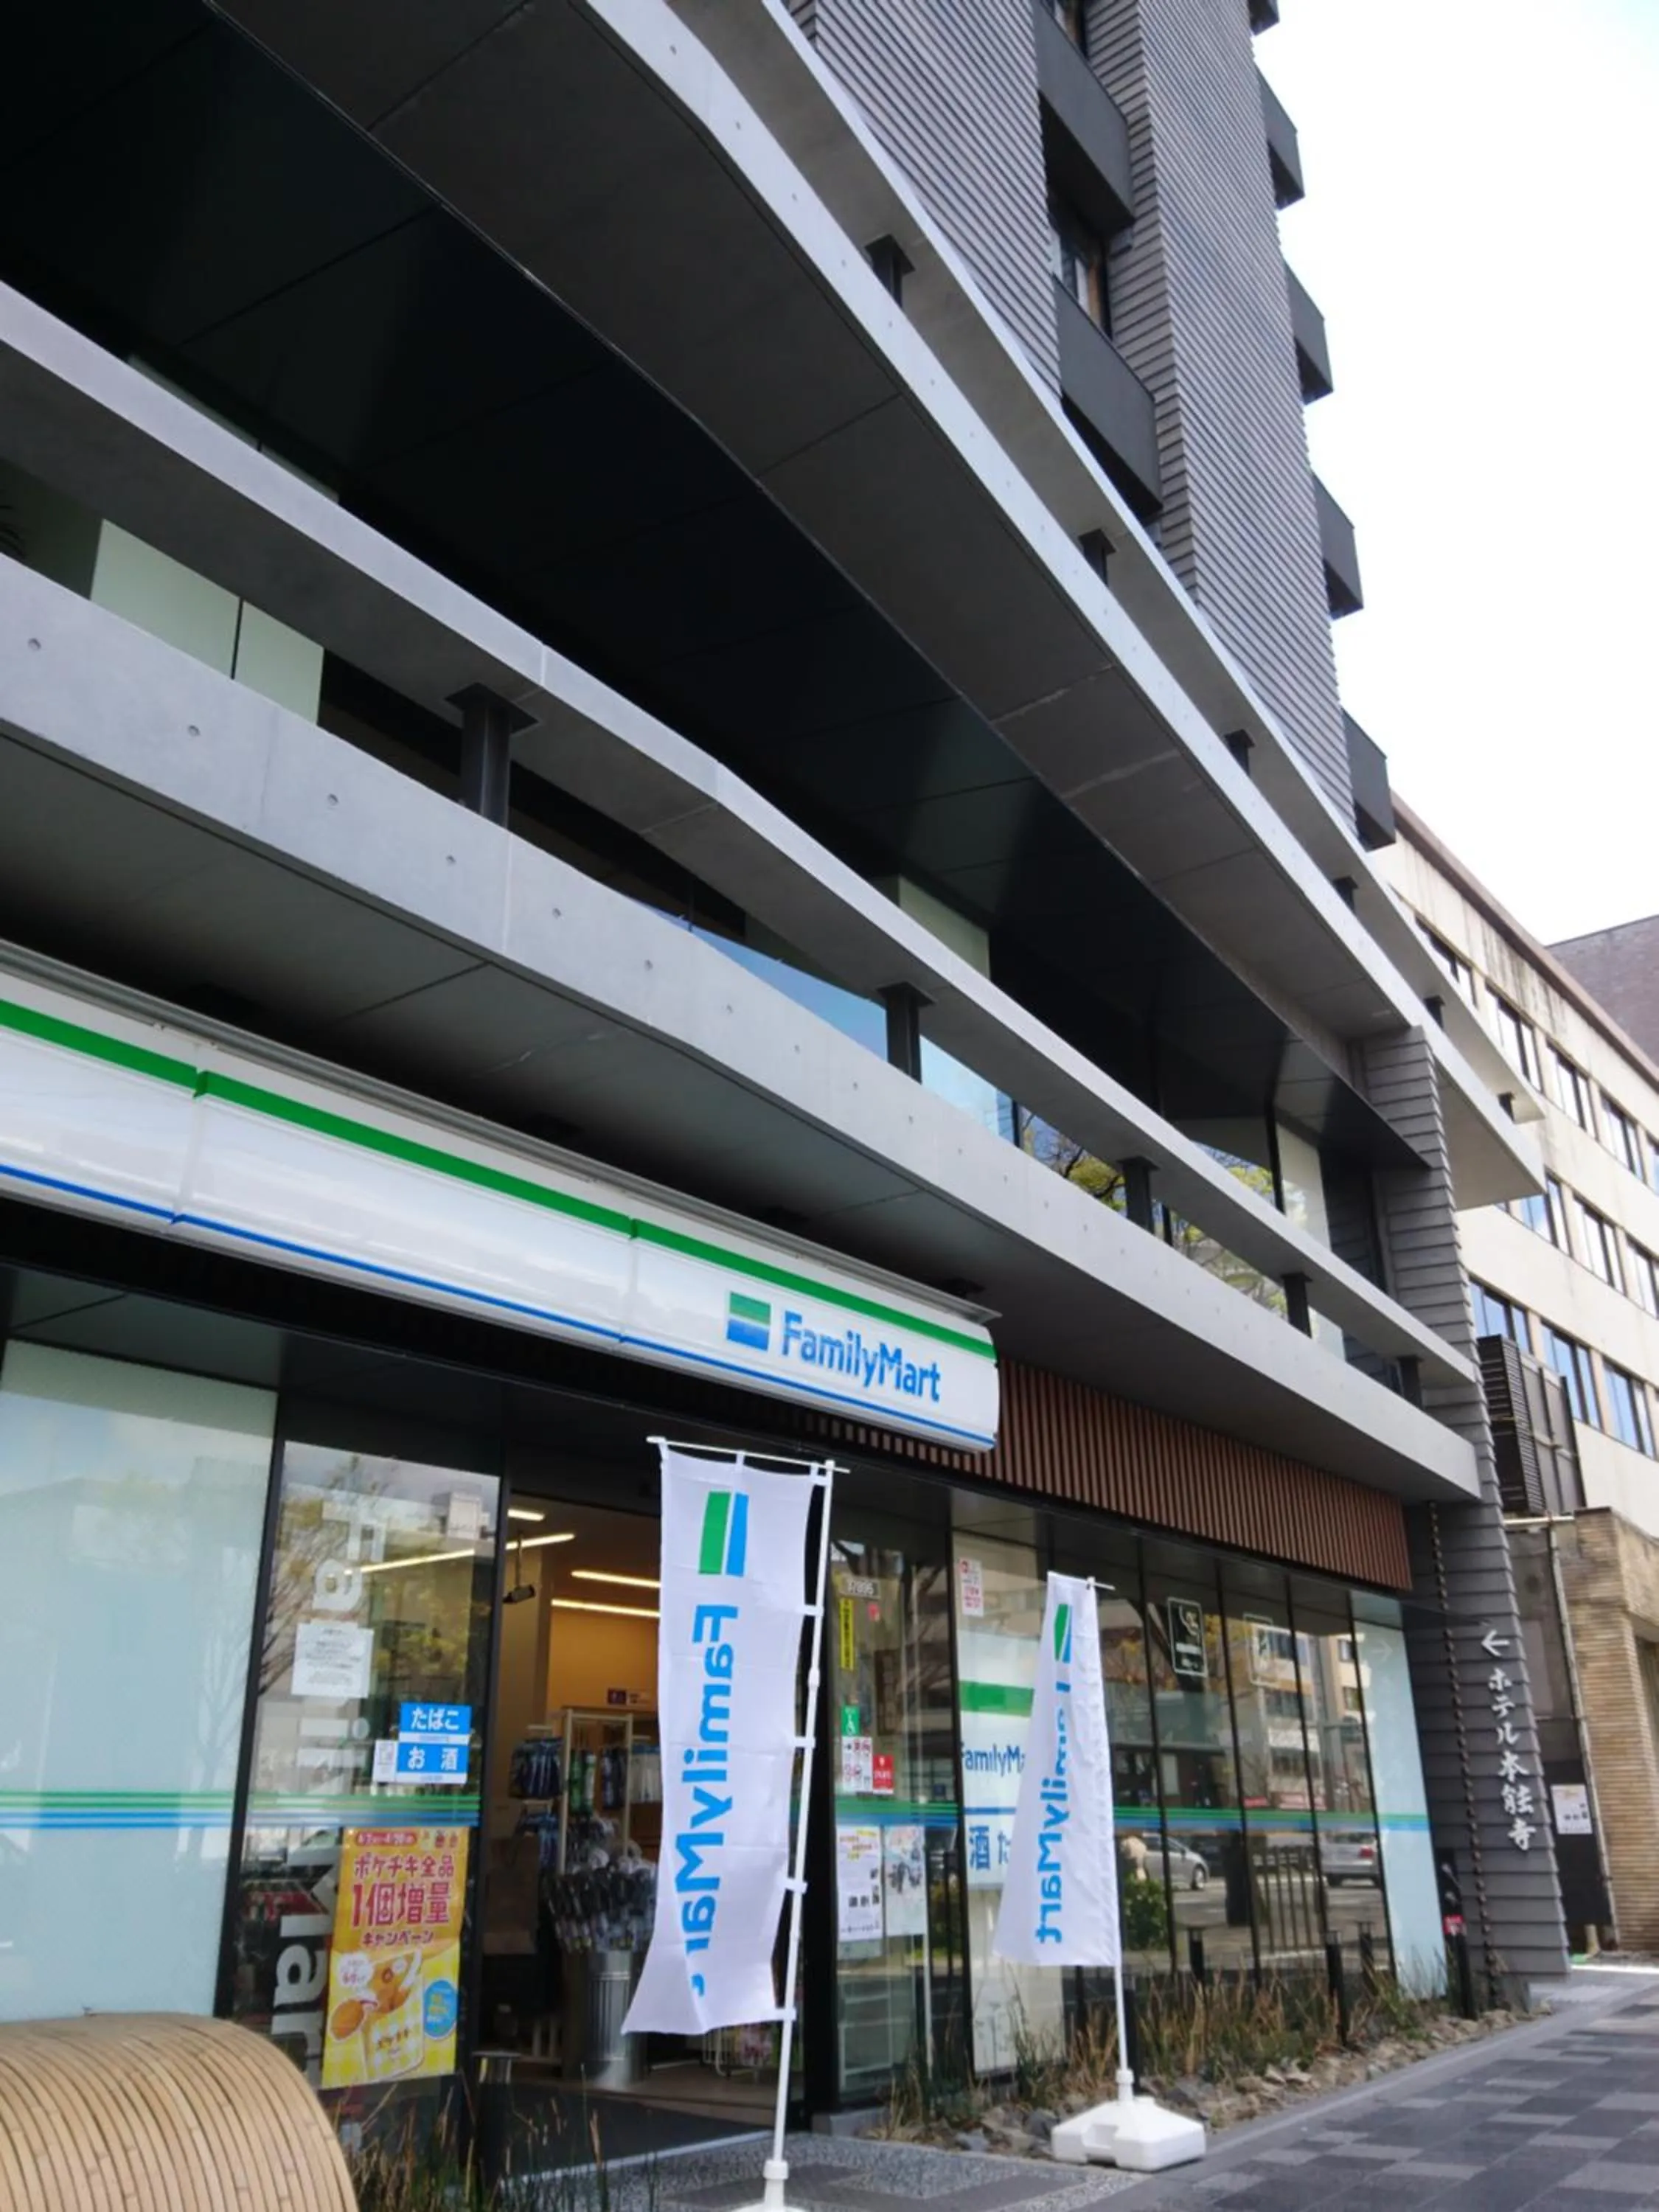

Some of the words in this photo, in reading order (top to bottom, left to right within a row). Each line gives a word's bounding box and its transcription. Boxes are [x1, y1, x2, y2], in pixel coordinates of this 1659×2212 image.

[780, 1310, 941, 1402] FamilyMart
[411, 1707, 459, 1731] たばこ
[408, 1745, 458, 1770] お酒
[960, 1742, 1025, 1777] amilyM
[355, 1851, 454, 1878] ポケチキ全品
[353, 1881, 450, 1927] 1個増量
[362, 1930, 434, 1947] キャンペーン
